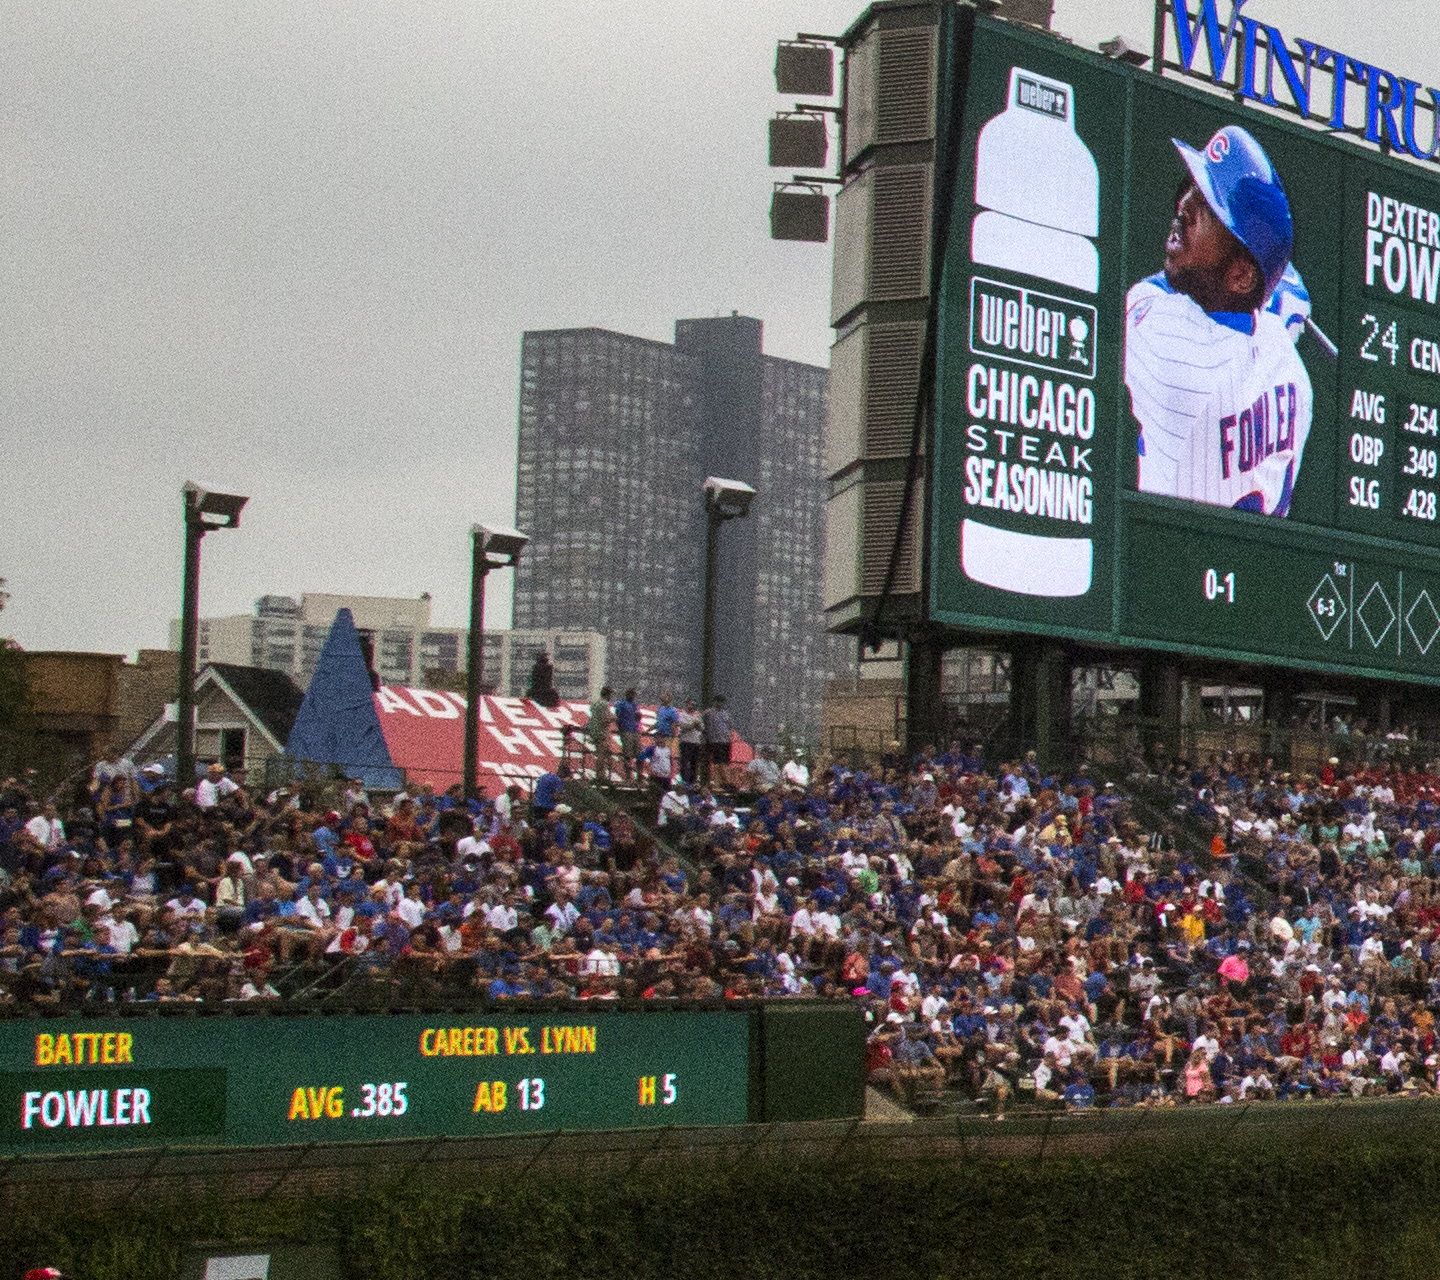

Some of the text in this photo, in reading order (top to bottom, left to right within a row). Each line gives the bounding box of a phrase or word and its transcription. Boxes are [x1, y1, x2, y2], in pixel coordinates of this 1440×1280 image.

[1367, 191, 1440, 249] DEXTER
[980, 289, 1066, 359] weber
[1359, 314, 1399, 365] 24
[966, 363, 1095, 440] CHICAGO
[1350, 389, 1385, 424] AVG
[1403, 403, 1439, 436] .254
[966, 424, 1092, 472] STEAK
[1350, 433, 1384, 466] OBP
[1403, 445, 1438, 478] .349
[964, 455, 1093, 524] SEASONING
[1349, 476, 1380, 509] SLG
[1402, 488, 1437, 520] .428
[1204, 568, 1235, 603] 0-1
[1316, 598, 1335, 616] 6-3
[34, 1026, 597, 1066] BATTER CAREER VS. LYNN
[21, 1073, 678, 1129] FOWLER AVG .385 AB 13 H 5
